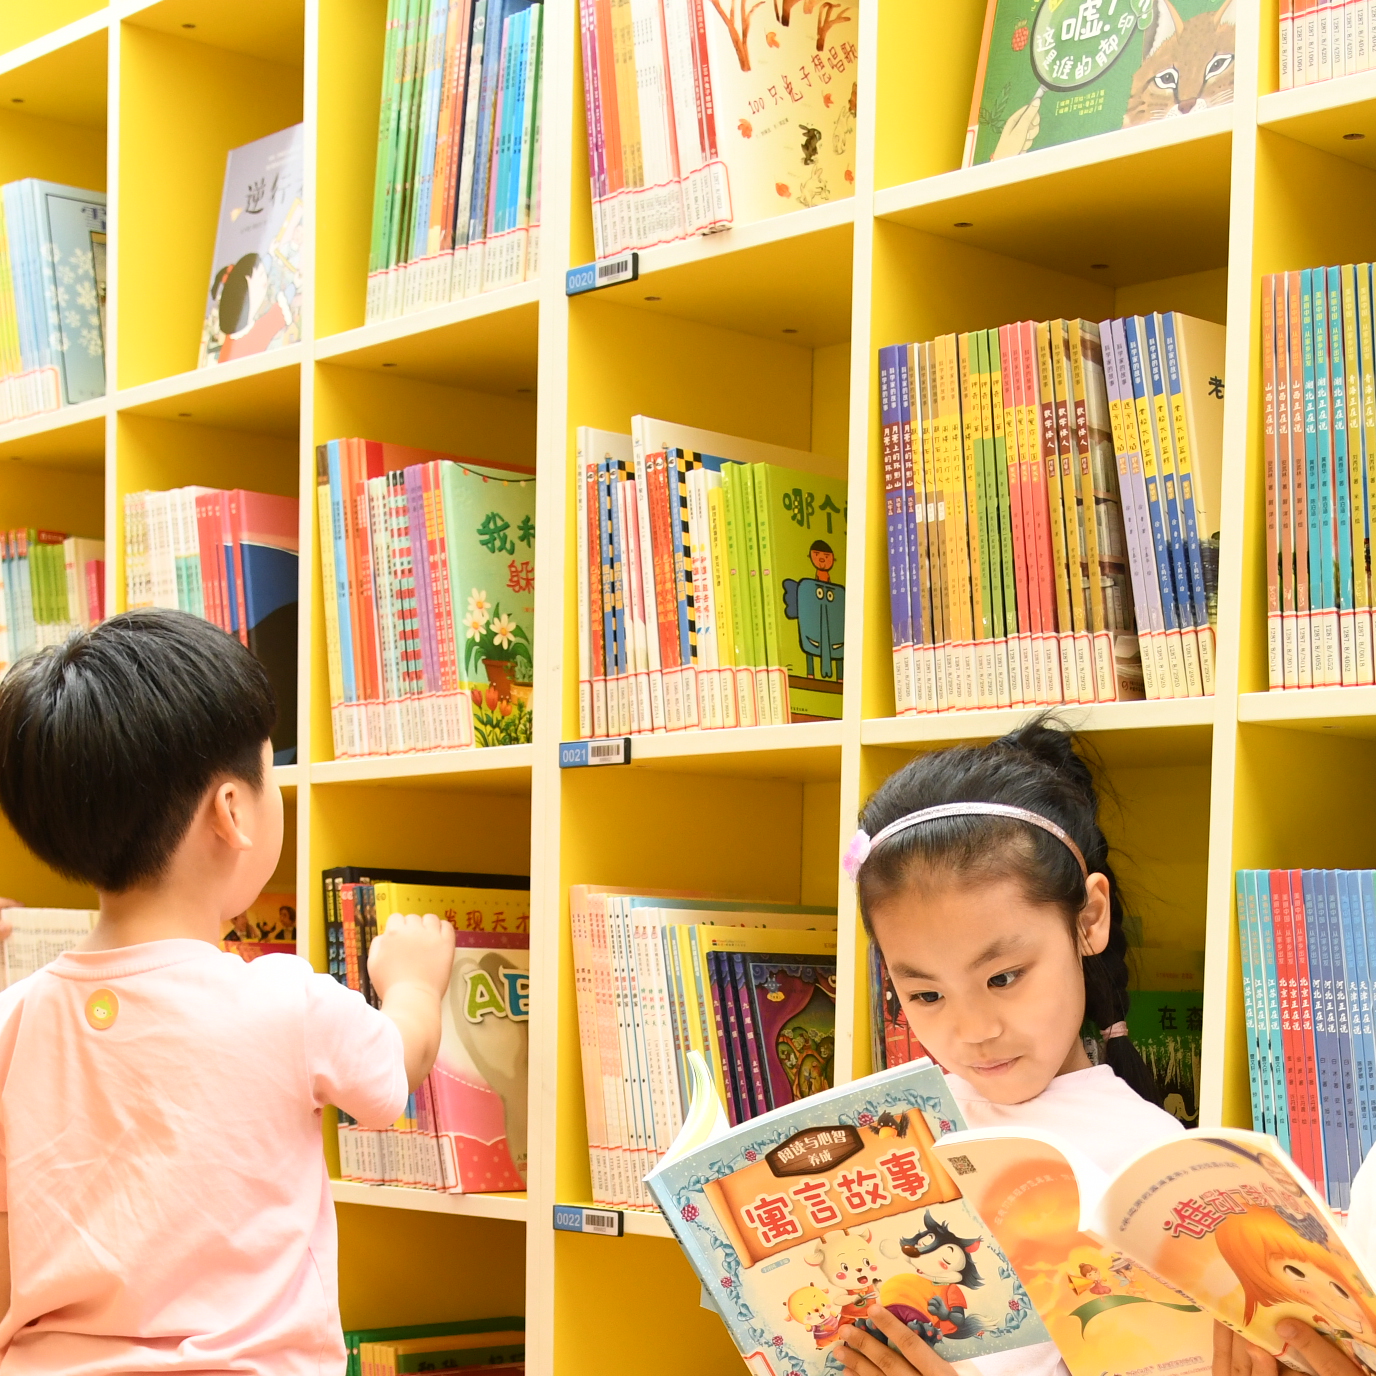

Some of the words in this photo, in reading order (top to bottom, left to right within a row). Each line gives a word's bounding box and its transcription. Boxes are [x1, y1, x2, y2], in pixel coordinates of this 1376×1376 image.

[246, 170, 303, 215] 逆行
[569, 272, 594, 290] 0020
[1265, 383, 1273, 435] 山西正在说
[1279, 382, 1287, 434] 山西正在说
[1293, 380, 1302, 433] 山西正在说
[1348, 374, 1358, 429] 青海正在说
[1364, 374, 1374, 427] 青海正在说
[783, 487, 847, 534] 哪个
[562, 748, 586, 764] 0021
[1279, 978, 1291, 1030] 北京正在说
[1289, 978, 1301, 1031] 北京正在说
[1300, 977, 1311, 1030] 北京正在说
[1312, 980, 1324, 1032] 河北正在说
[1324, 980, 1336, 1033] 河北正在说
[1350, 982, 1362, 1034] 天津正在说
[1360, 981, 1371, 1034] 天津正在说
[777, 1130, 847, 1163] 阅读与心智
[808, 1150, 833, 1167] 养成
[556, 1211, 580, 1228] 0022
[745, 1151, 925, 1244] 寓言故事
